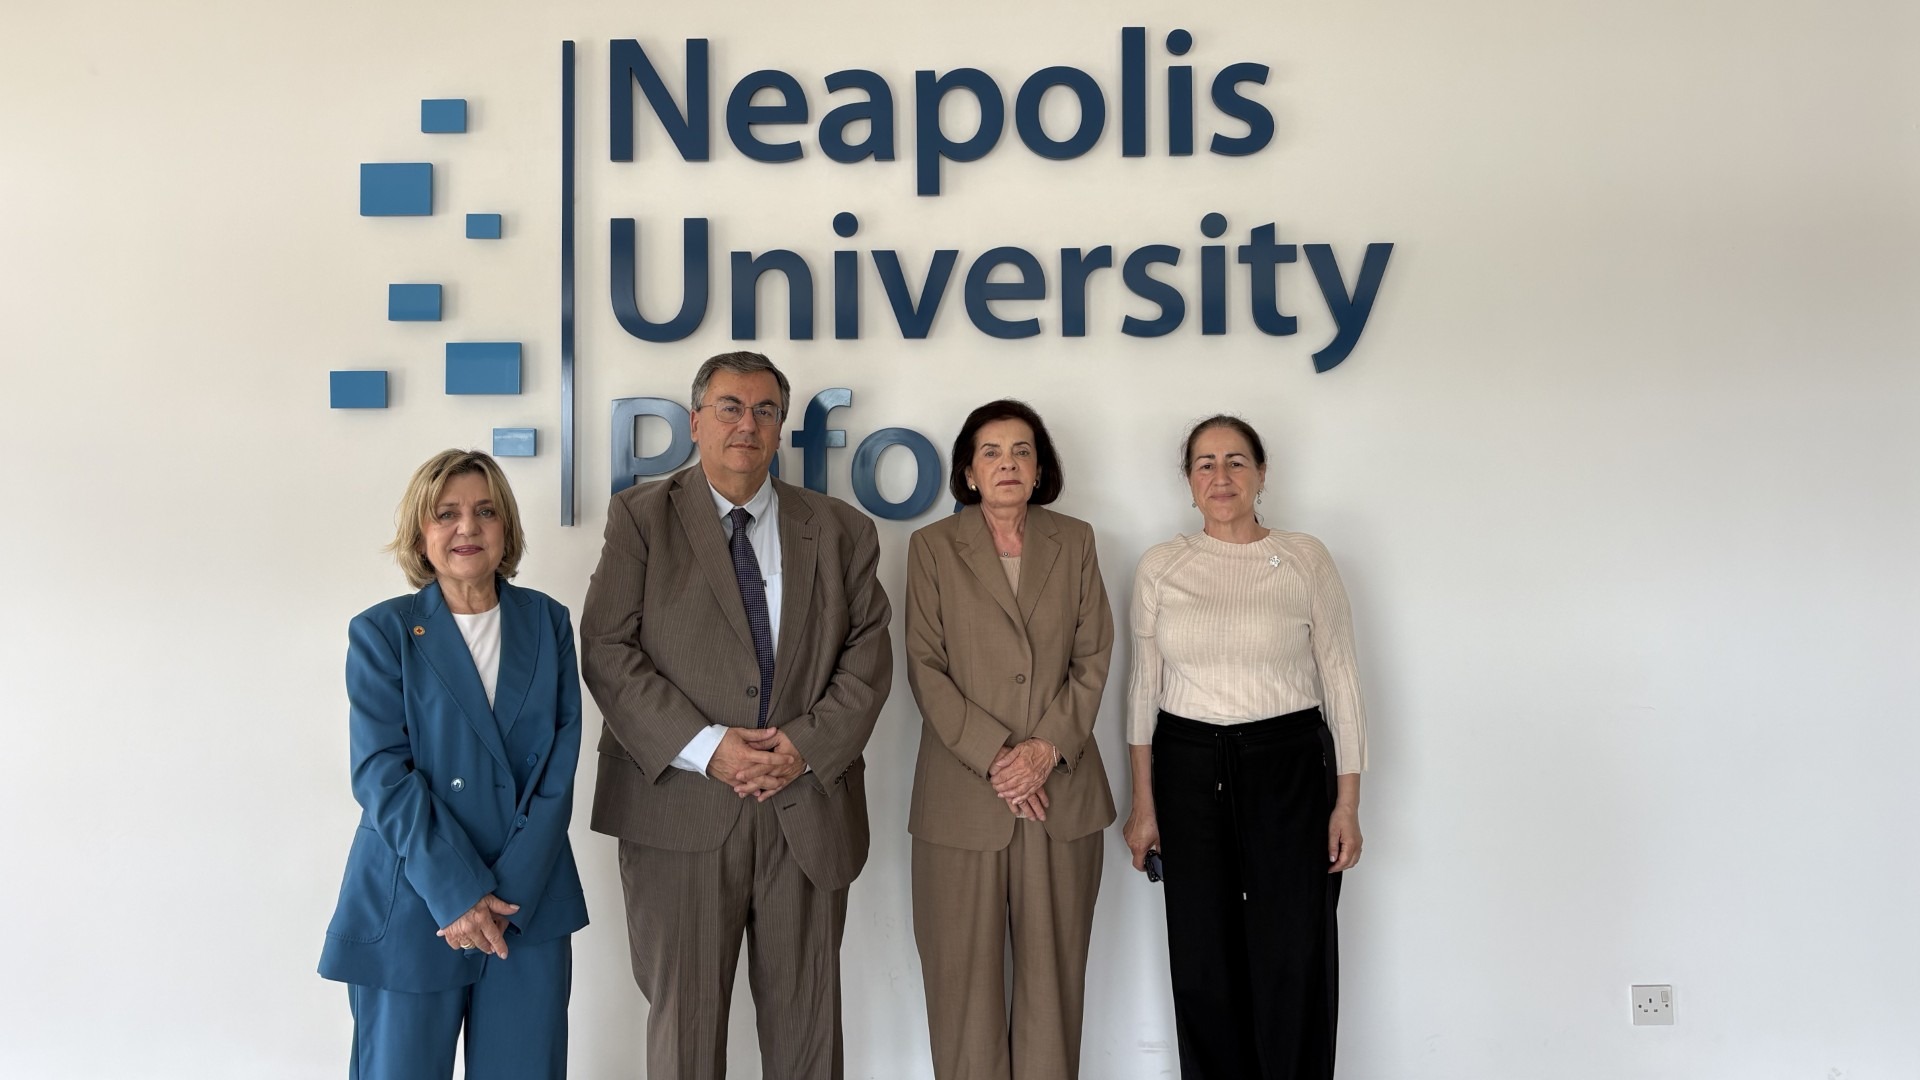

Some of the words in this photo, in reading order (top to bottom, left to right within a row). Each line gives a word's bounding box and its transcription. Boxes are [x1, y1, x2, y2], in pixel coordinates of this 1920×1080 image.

[609, 27, 1275, 196] Neapolis
[609, 212, 1394, 373] University
[611, 387, 965, 520] Pfo
